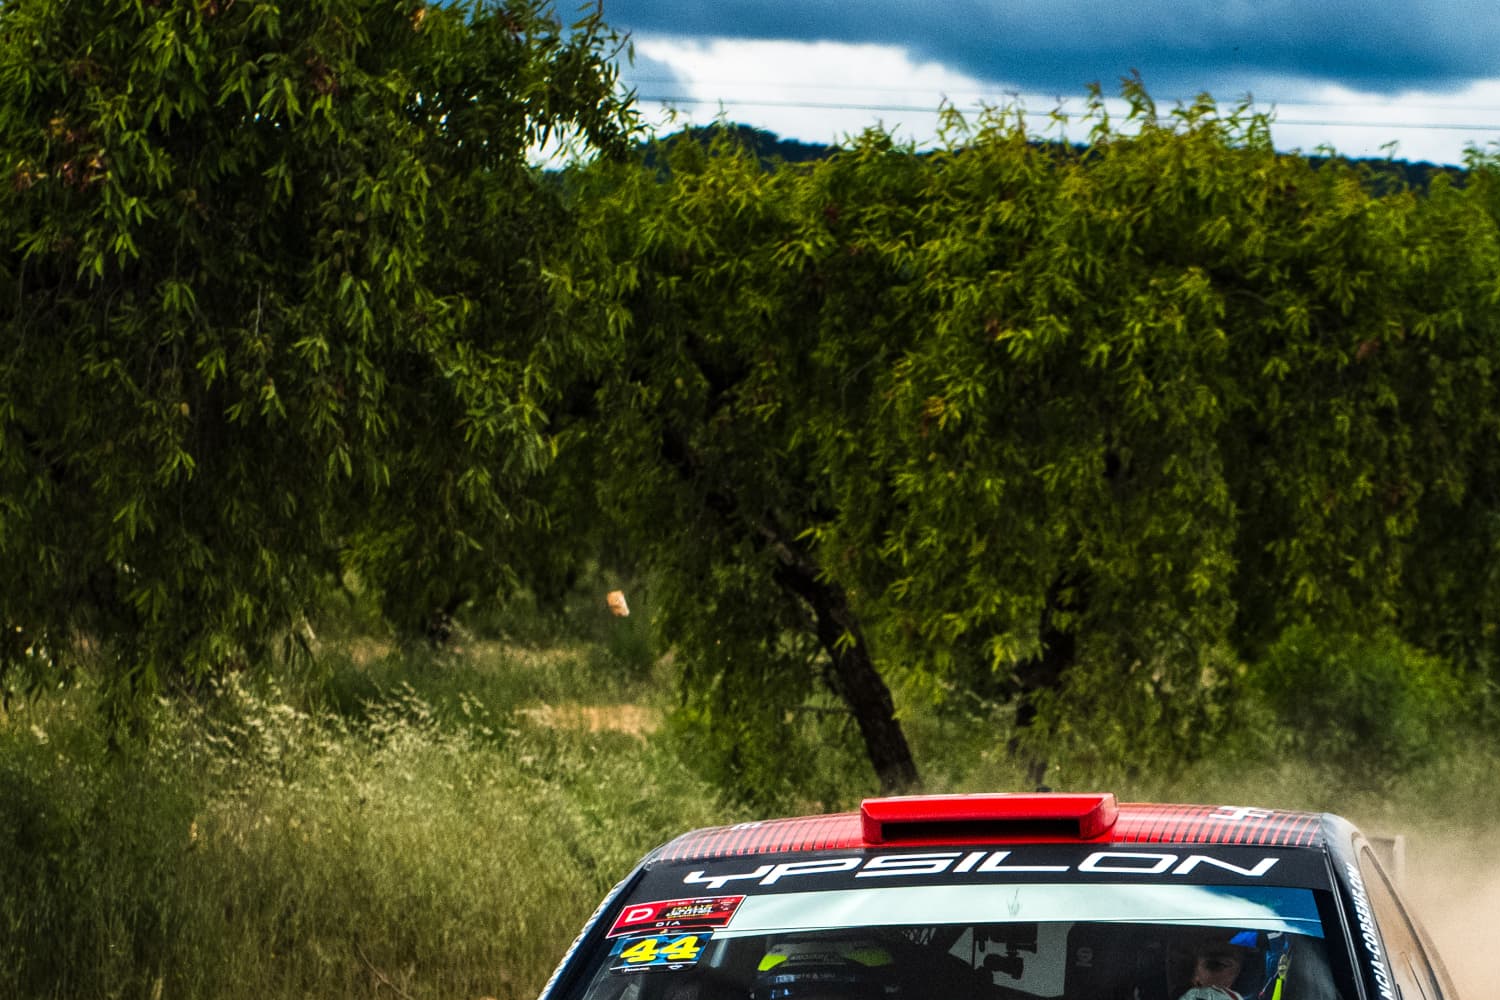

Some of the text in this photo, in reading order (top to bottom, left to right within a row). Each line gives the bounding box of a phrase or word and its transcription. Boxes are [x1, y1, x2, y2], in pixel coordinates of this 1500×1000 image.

[683, 850, 1280, 889] YPSILON
[625, 907, 654, 923] D
[620, 935, 700, 963] 44
